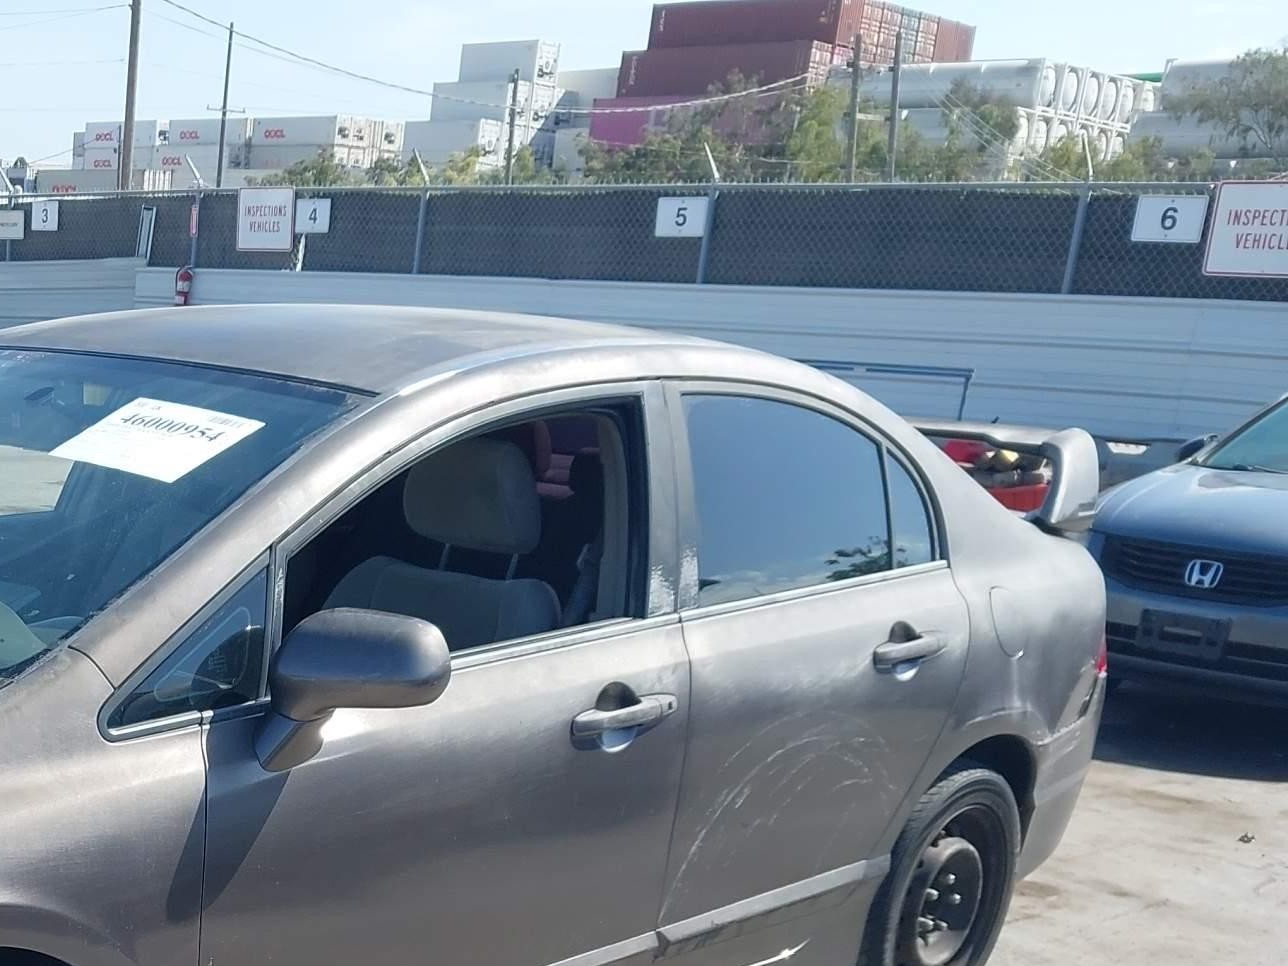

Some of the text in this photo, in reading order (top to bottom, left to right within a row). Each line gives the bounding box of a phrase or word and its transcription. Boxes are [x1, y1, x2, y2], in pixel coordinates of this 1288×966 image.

[41, 208, 49, 224] 3
[244, 205, 287, 217] INSPECTIONS
[308, 208, 318, 224] 4
[675, 207, 688, 227] 5
[1160, 206, 1179, 231] 6
[1227, 208, 1288, 226] INSPECT
[248, 221, 280, 233] VEHICLES
[1235, 232, 1288, 250] VEHICL
[120, 413, 226, 442] 46000954
